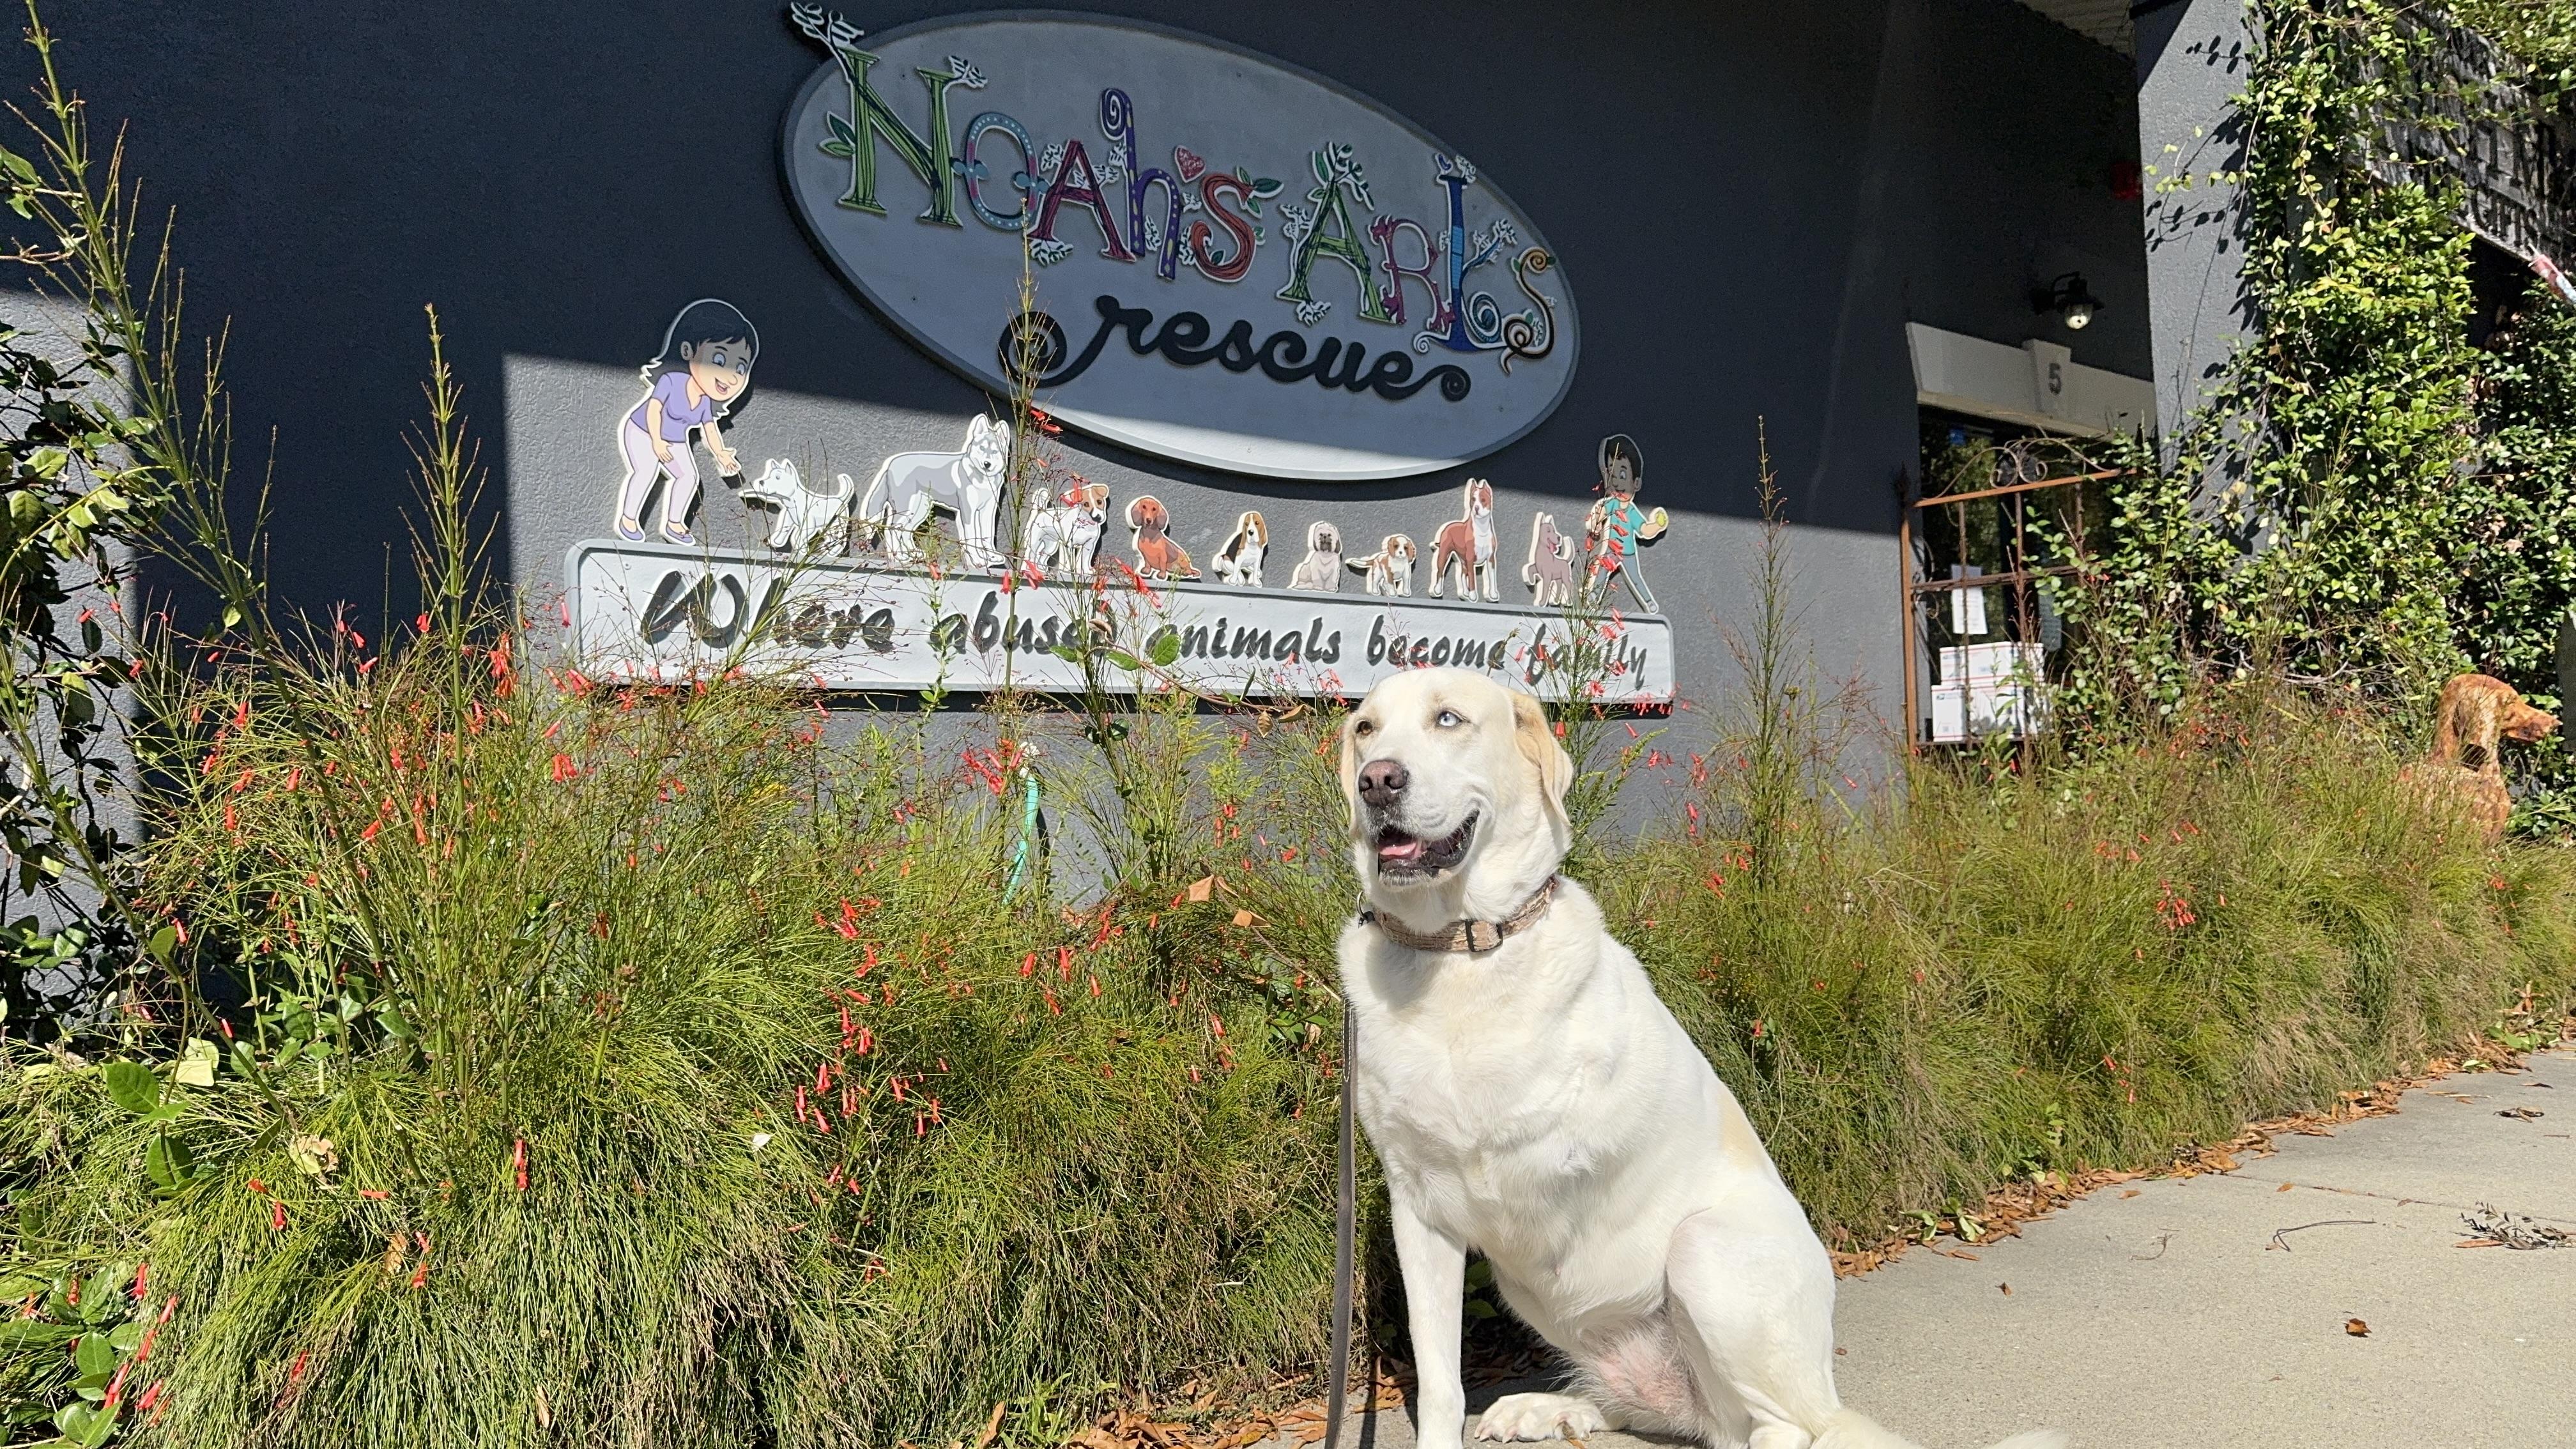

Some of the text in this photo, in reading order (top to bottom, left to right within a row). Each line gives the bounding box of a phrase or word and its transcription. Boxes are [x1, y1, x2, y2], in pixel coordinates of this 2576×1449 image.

[998, 295, 1471, 401] rescue
[2048, 362, 2062, 395] 5
[1367, 613, 1505, 670] become
[1525, 622, 1646, 691] faily
